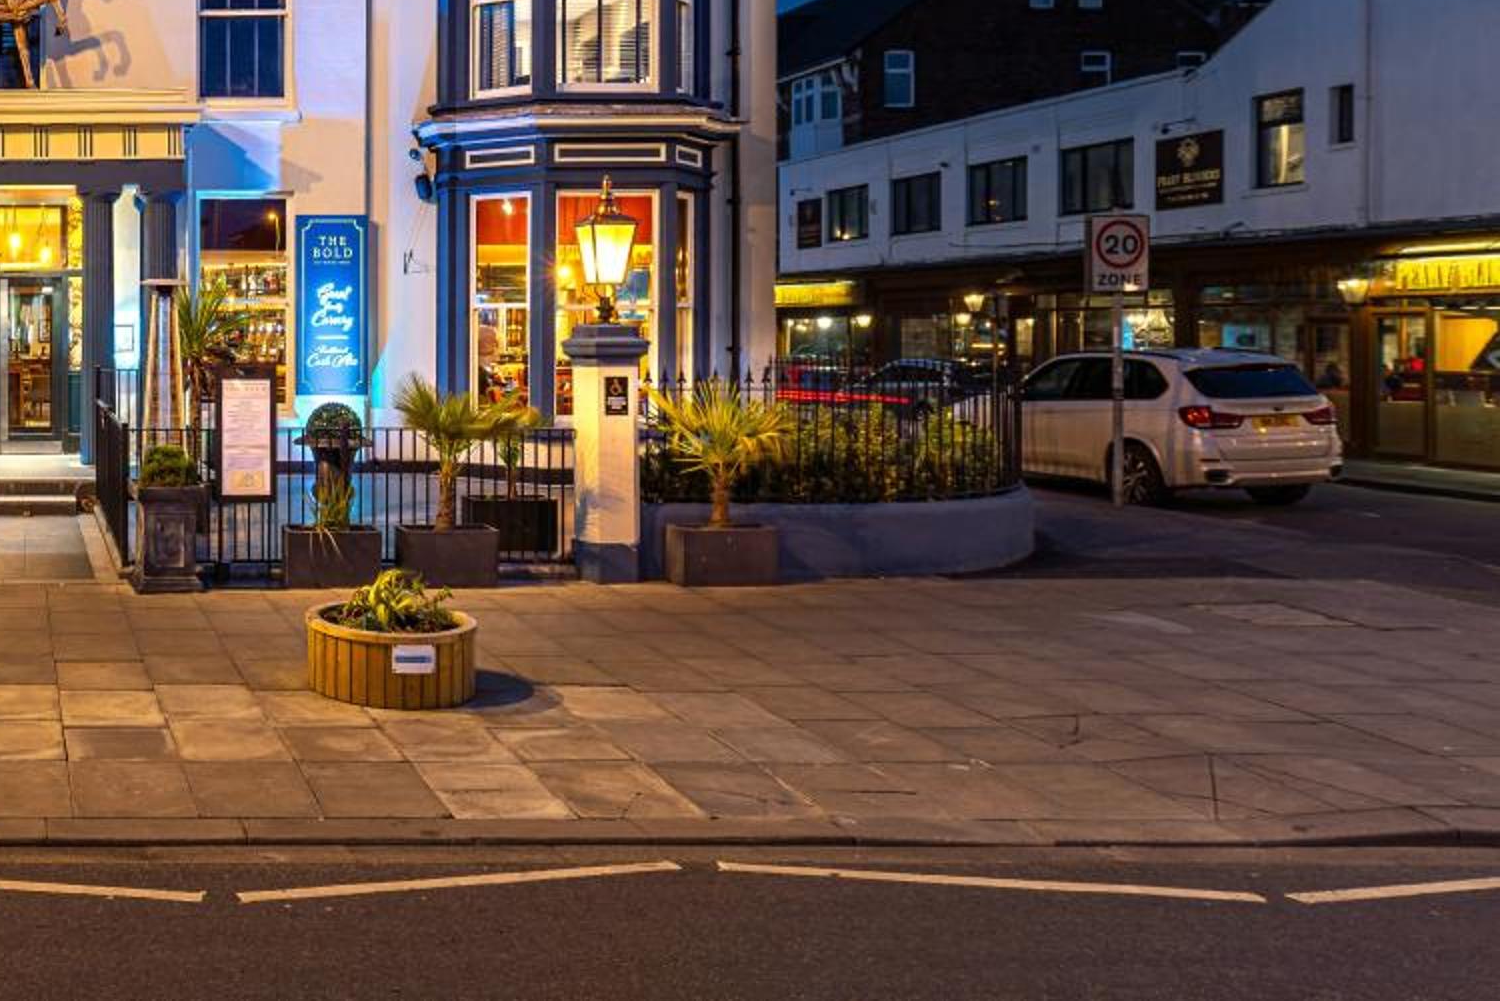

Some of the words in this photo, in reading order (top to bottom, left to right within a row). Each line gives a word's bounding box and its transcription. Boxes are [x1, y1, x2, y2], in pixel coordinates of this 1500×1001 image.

[318, 235, 348, 247] THE
[1105, 234, 1139, 255] 20
[312, 247, 354, 260] BOLD
[1098, 274, 1143, 286] ZONE
